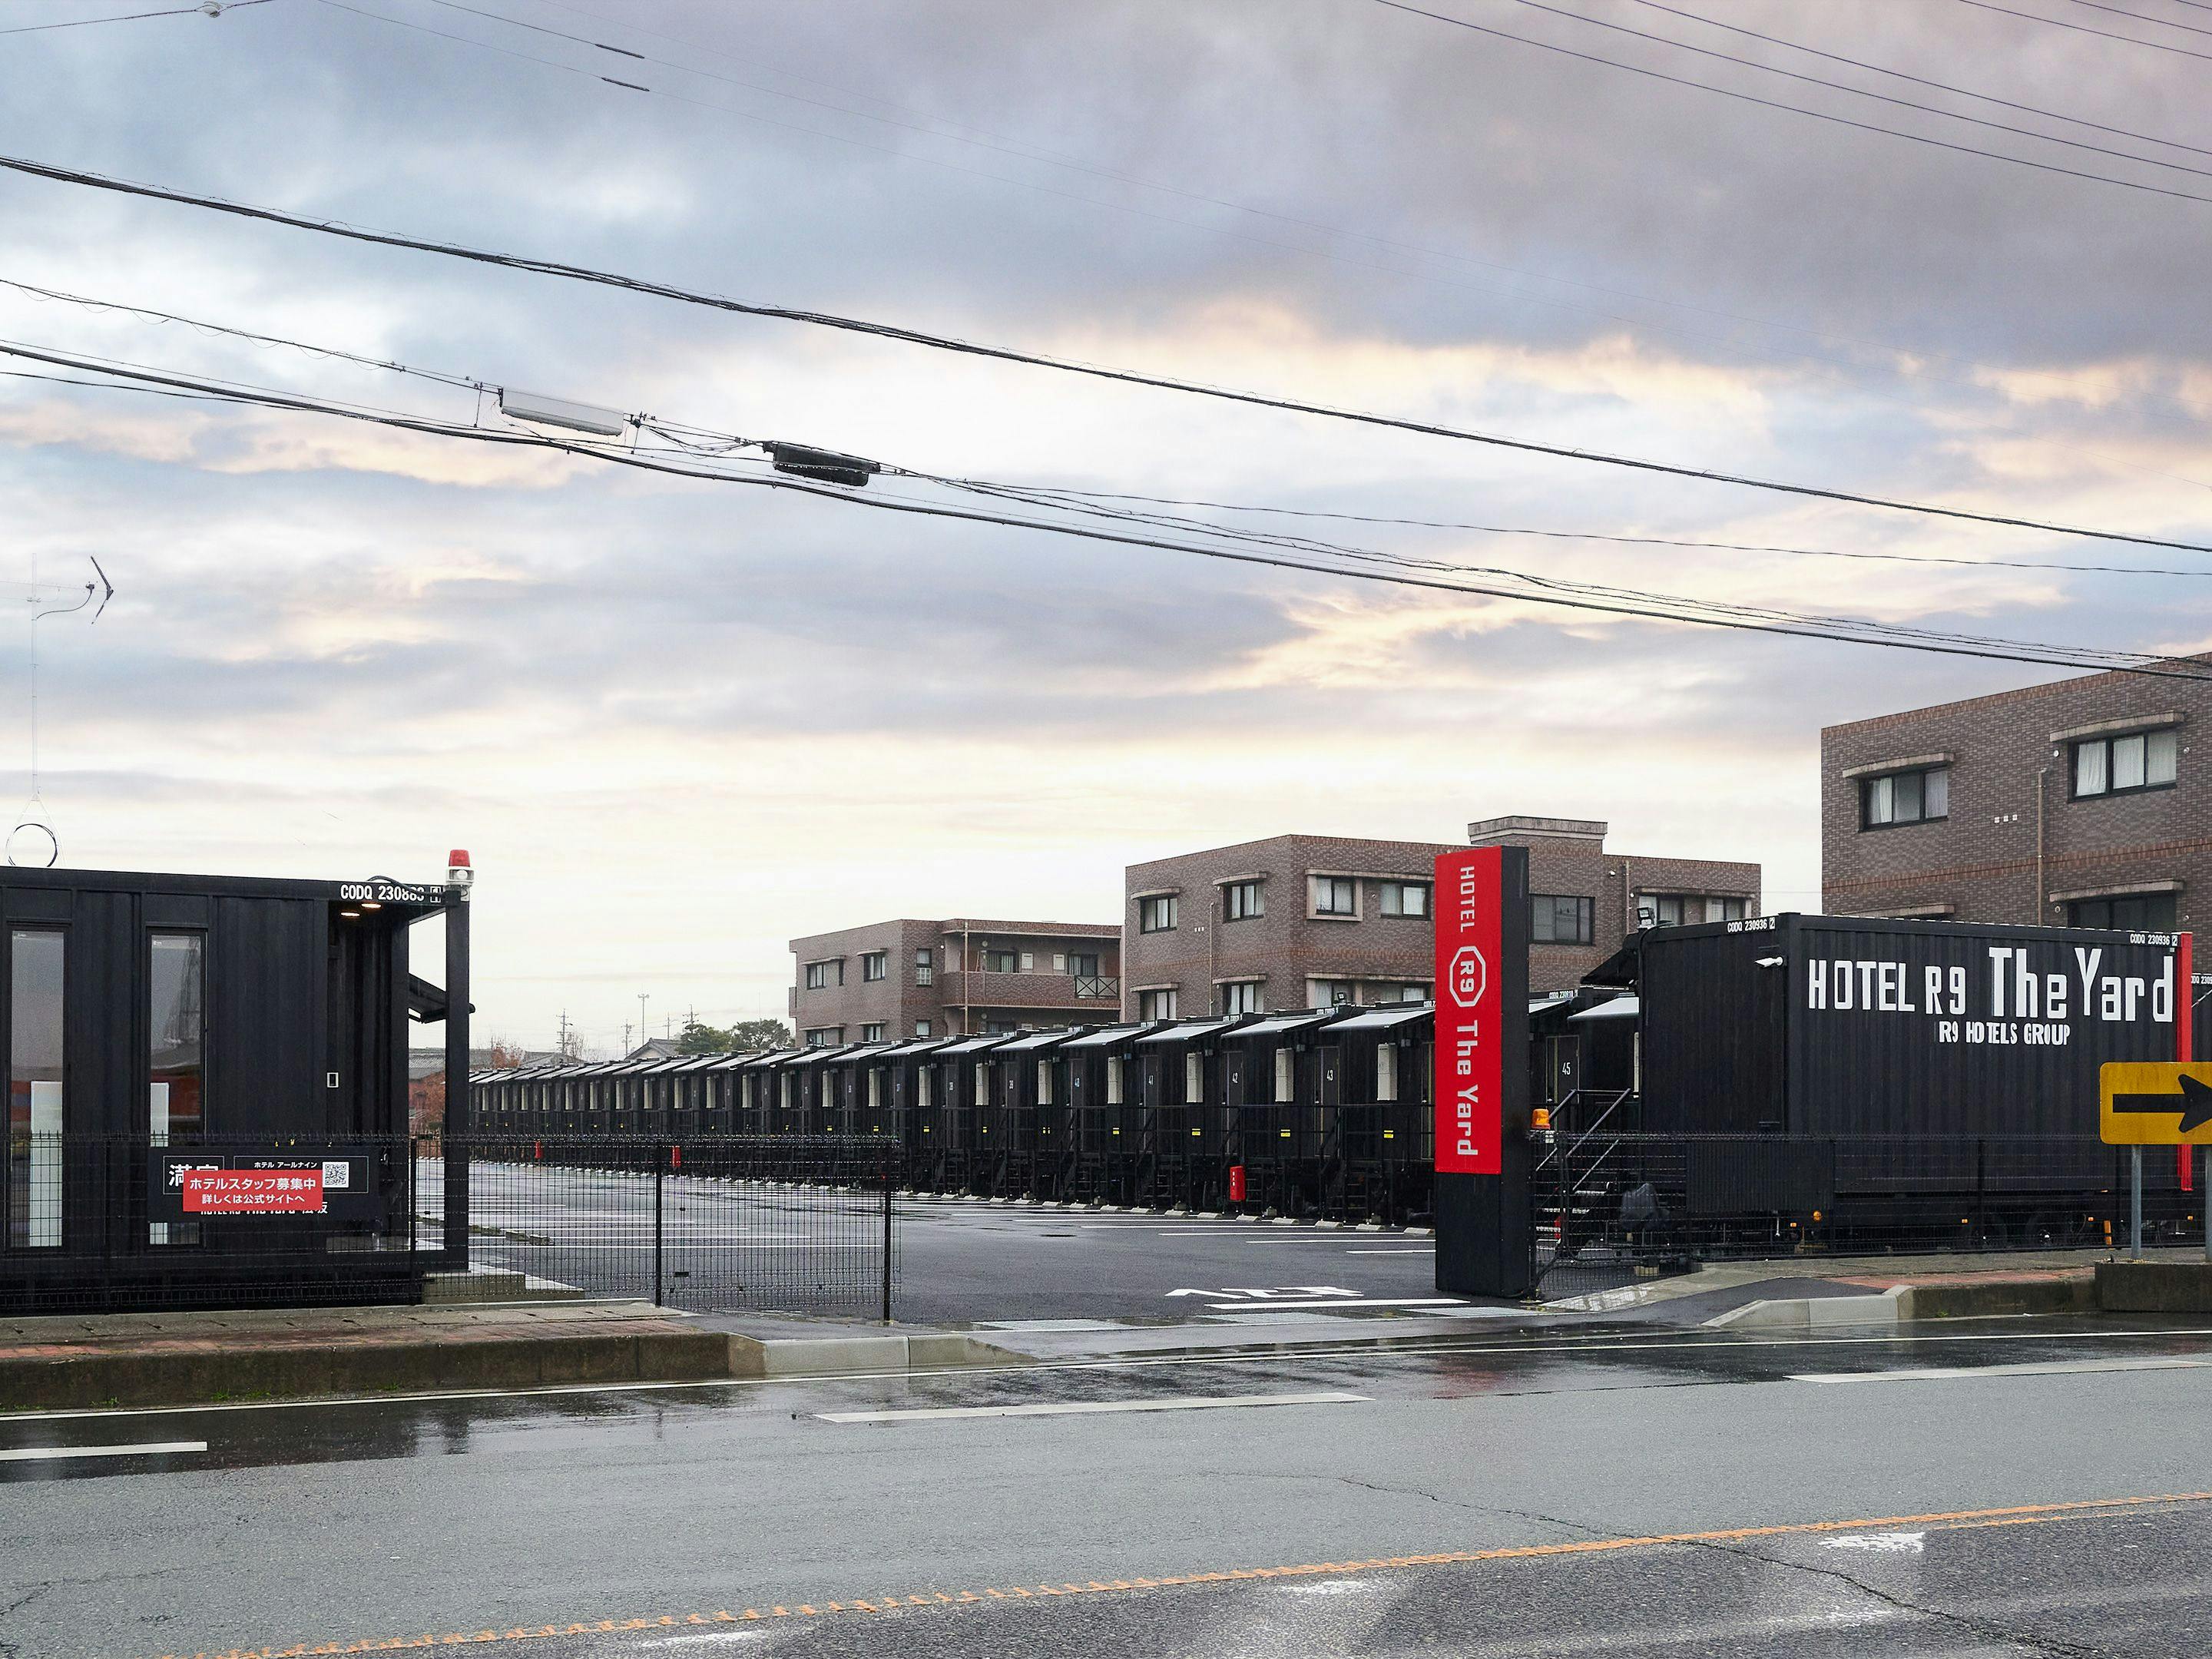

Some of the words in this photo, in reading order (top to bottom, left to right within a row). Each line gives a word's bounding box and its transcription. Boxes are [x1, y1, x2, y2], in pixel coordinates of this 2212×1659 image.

[340, 884, 373, 900] CODQ
[1460, 866, 1475, 932] HOTEL
[1727, 922, 1743, 932] CODQ
[1744, 919, 1767, 931] 230936
[2130, 933, 2146, 944] CODQ
[2147, 934, 2171, 945] 230936
[1459, 960, 1474, 992] R9
[1809, 959, 1916, 1012] HOTEL
[1926, 965, 1966, 1015] R9
[1988, 947, 2068, 1018] The
[2075, 947, 2173, 1023] Yard
[1939, 1022, 1959, 1043] R9
[1966, 1022, 2018, 1045] HOTELS
[2024, 1022, 2071, 1046] GROUP
[1456, 1020, 1478, 1075] The
[1326, 1069, 1333, 1081] 43
[1561, 1062, 1571, 1075] 45
[1457, 1084, 1478, 1155] Yard
[169, 1164, 219, 1187] 満
[190, 1177, 316, 1190] ホテルスタッフ募集中
[202, 1194, 305, 1204] 詳しくは公式サイトへ
